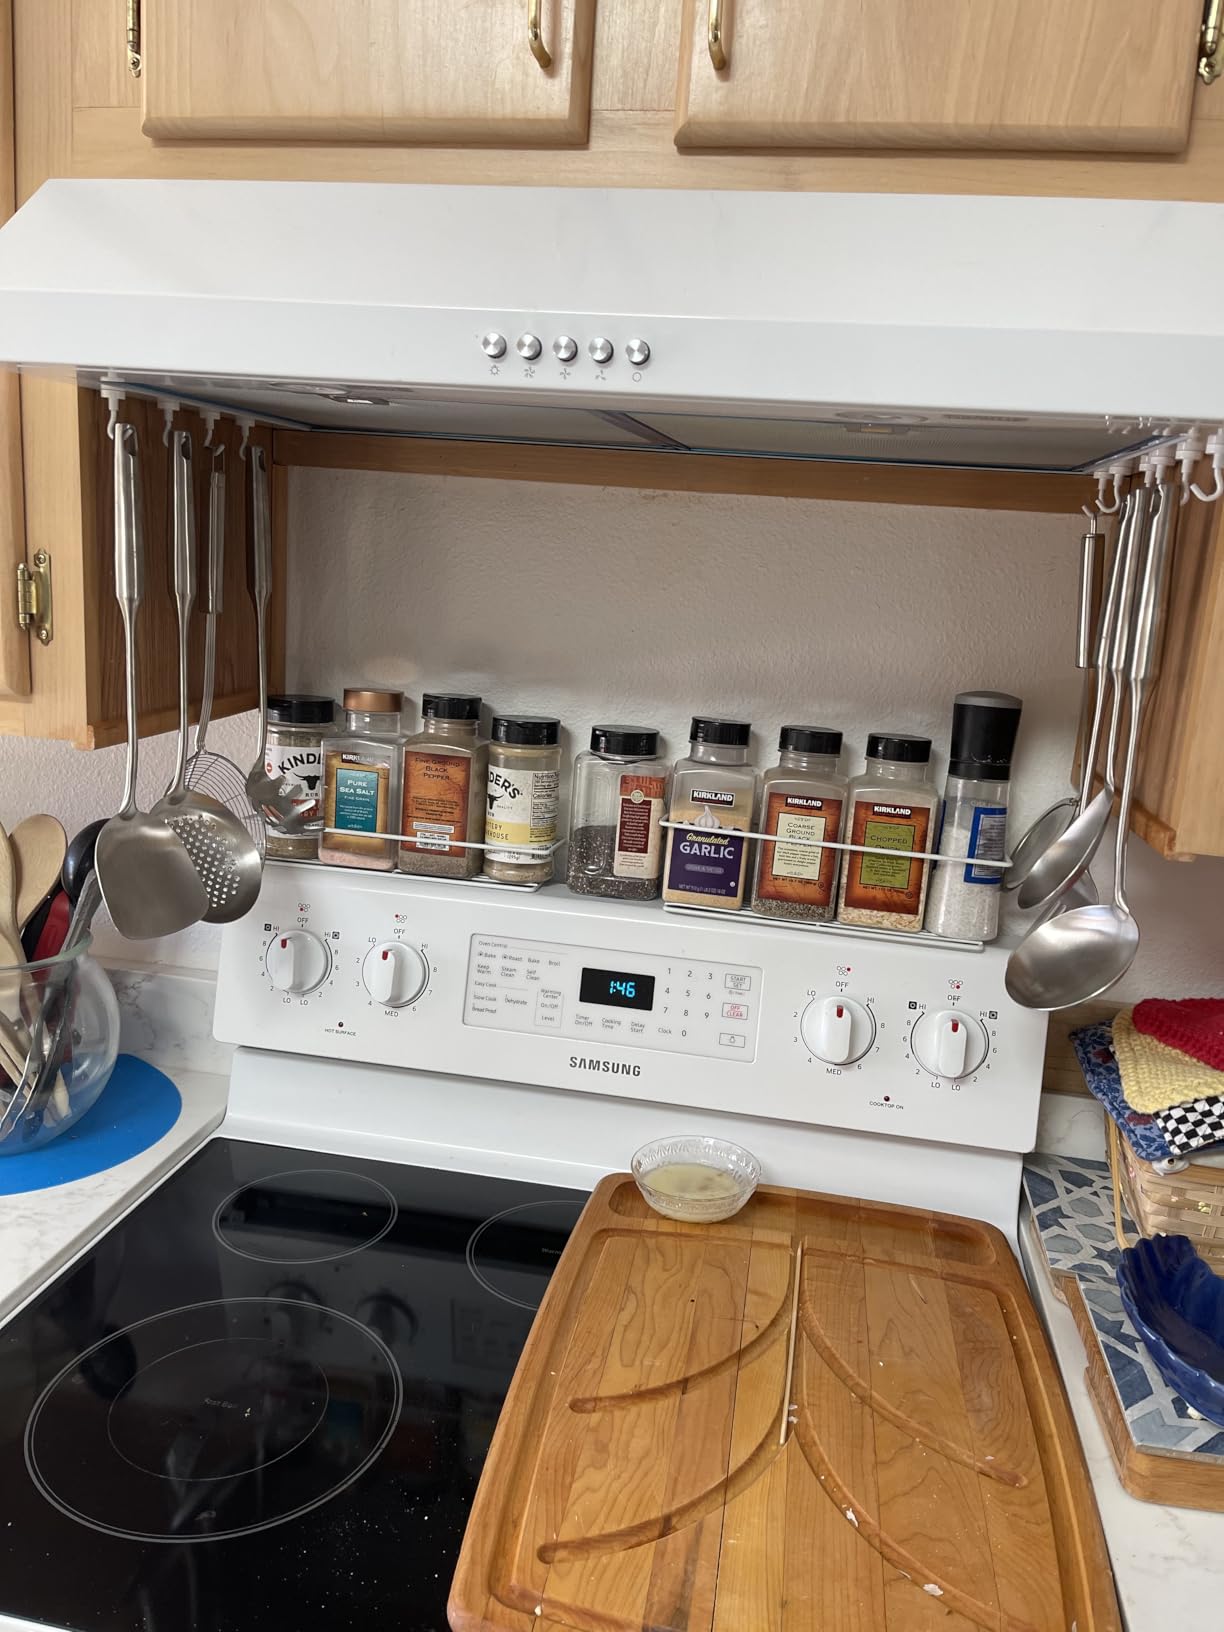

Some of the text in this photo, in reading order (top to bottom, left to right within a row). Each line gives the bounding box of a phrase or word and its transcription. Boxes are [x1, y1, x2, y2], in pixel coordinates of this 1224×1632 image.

[424, 773, 450, 781] PEPPER
[347, 780, 368, 788] PURE
[356, 788, 375, 796] SALT
[693, 790, 734, 802] KIRKLAND
[787, 797, 822, 808] KIRKLAND
[874, 805, 911, 816] KIRKLAND
[788, 822, 816, 830] COARSE
[786, 828, 816, 836] GROUND
[686, 832, 730, 845] Granulated
[870, 834, 908, 844] CHOPPED
[680, 842, 735, 859] GARLIC
[609, 980, 636, 998] 1:46
[664, 986, 670, 994] 4
[706, 992, 712, 1000] 6
[947, 994, 961, 1002] OFF
[504, 997, 528, 1006] Dehydrate
[384, 1010, 399, 1018] MED
[663, 1006, 668, 1014] 7
[683, 1009, 689, 1017] 8
[602, 1017, 622, 1026] Cooking
[630, 1021, 646, 1030] Delay
[335, 1029, 357, 1037] SURFACE
[658, 1027, 672, 1036] Clock
[569, 1056, 642, 1077] SAMSUNG
[826, 1067, 842, 1076] MED
[869, 1101, 894, 1109] COOKTOP
